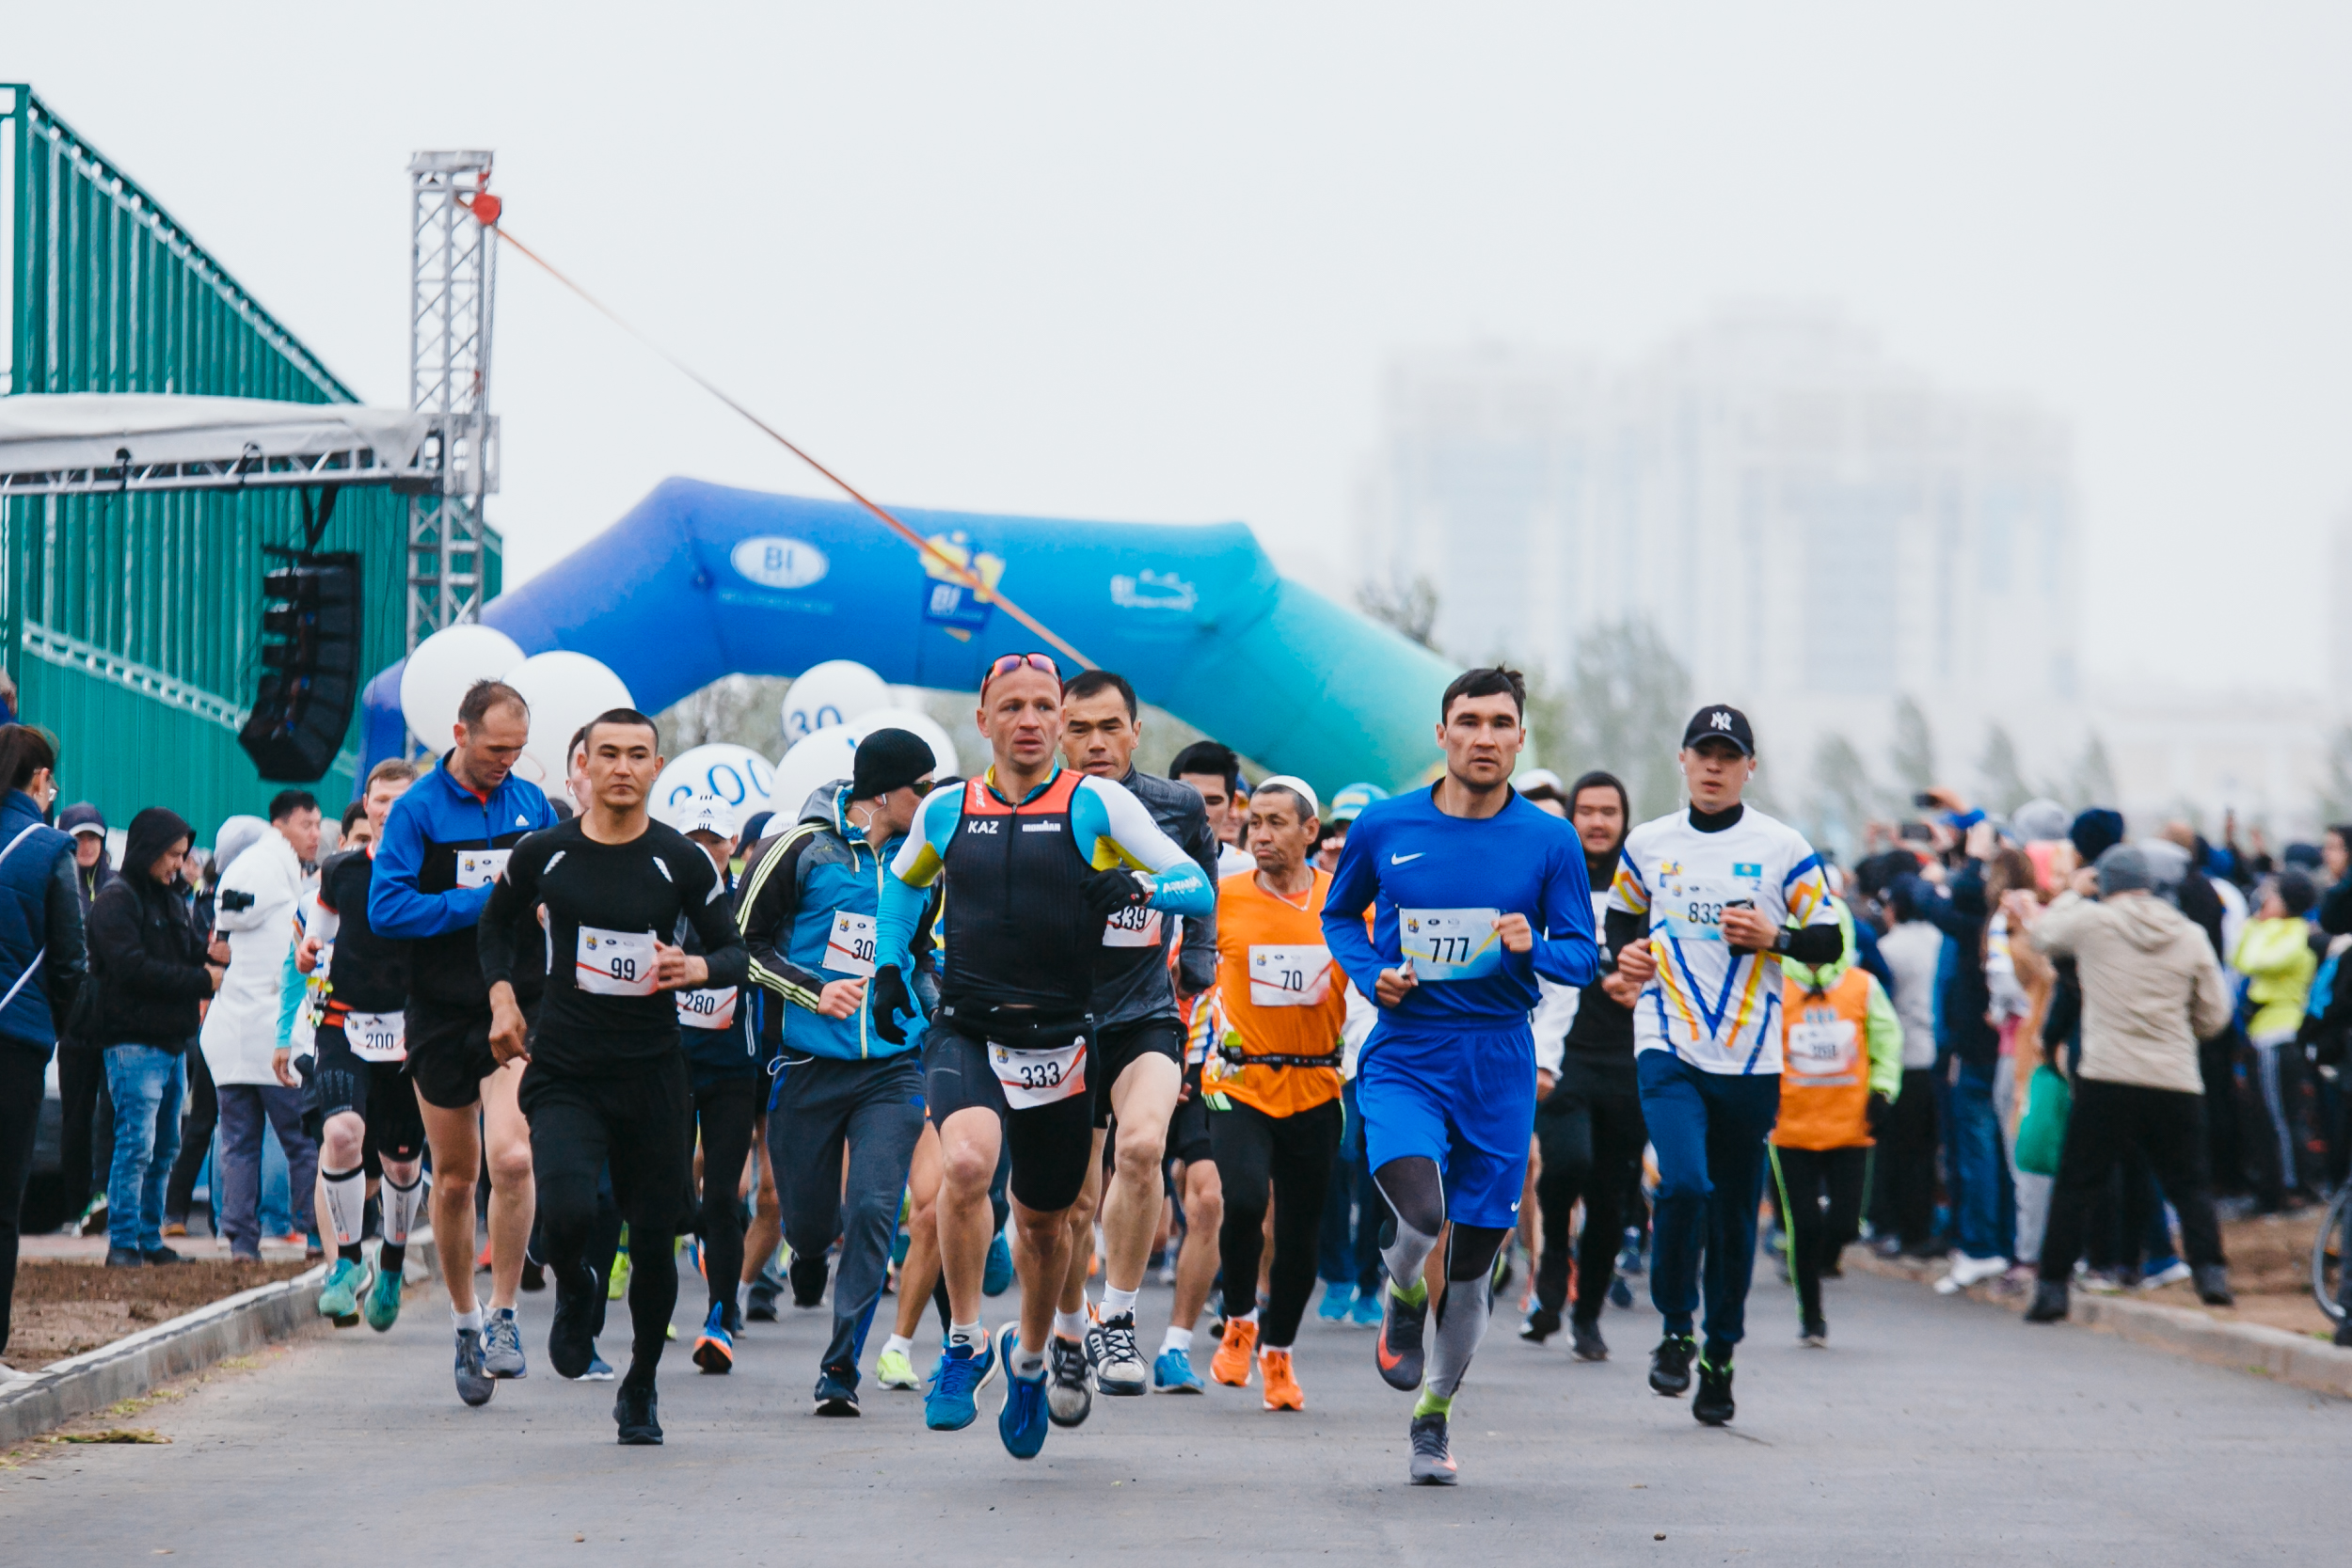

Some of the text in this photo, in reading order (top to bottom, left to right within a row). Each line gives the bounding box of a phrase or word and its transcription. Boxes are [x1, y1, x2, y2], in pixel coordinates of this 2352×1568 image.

[763, 546, 793, 572] BI
[967, 820, 999, 834] KAZ
[1689, 902, 1723, 925] 833
[1429, 937, 1470, 963] 777
[611, 958, 635, 981] 99
[1280, 970, 1302, 991] 70
[683, 992, 715, 1015] 280
[366, 1033, 394, 1050] 200
[1021, 1061, 1060, 1090] 333
